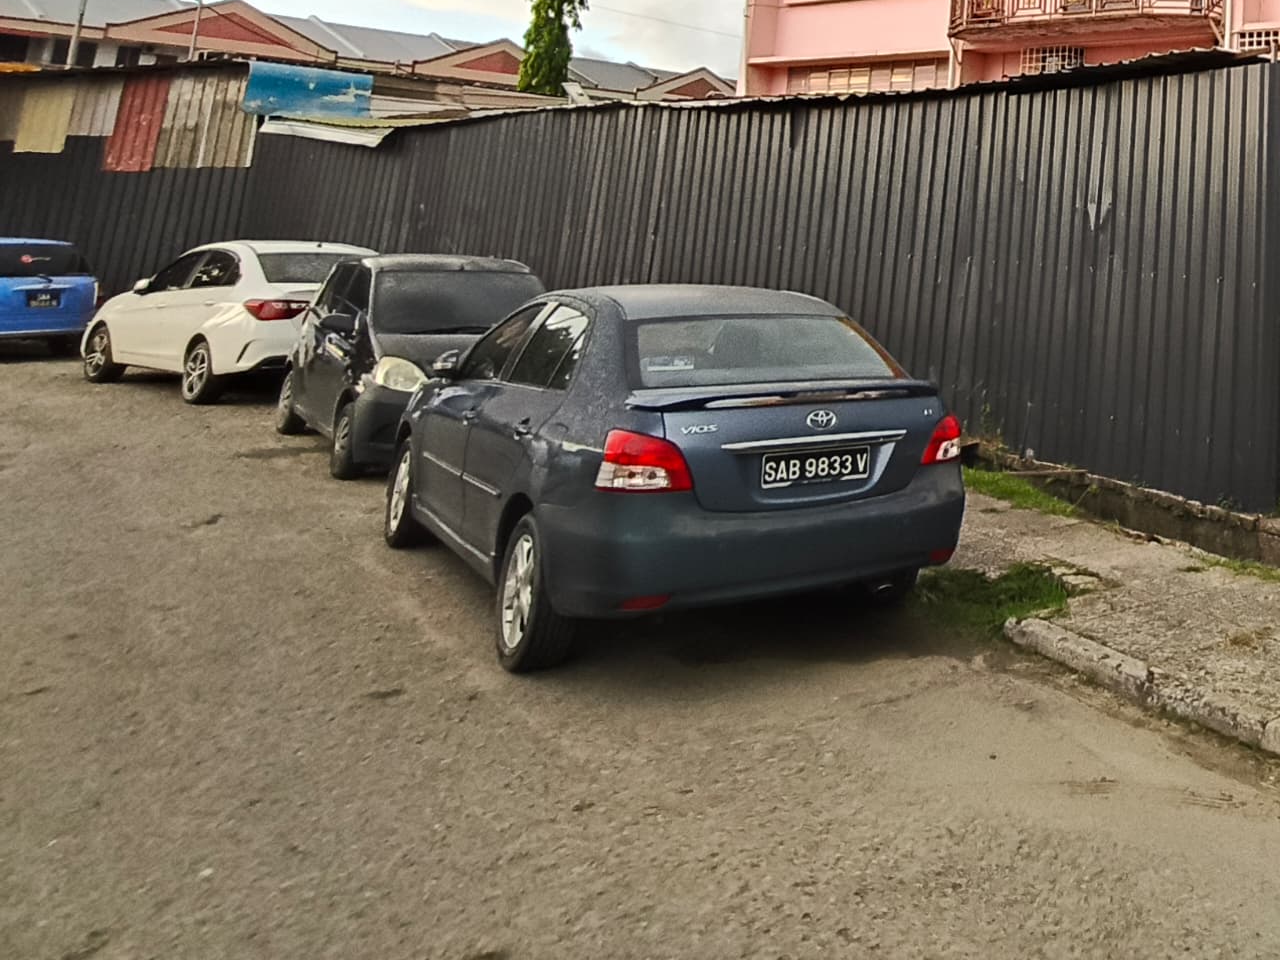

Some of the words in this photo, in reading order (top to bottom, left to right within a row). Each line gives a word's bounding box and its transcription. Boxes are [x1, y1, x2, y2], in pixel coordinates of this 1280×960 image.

[764, 459, 800, 482] SAB
[804, 454, 852, 478] 9833
[856, 453, 868, 473] V
